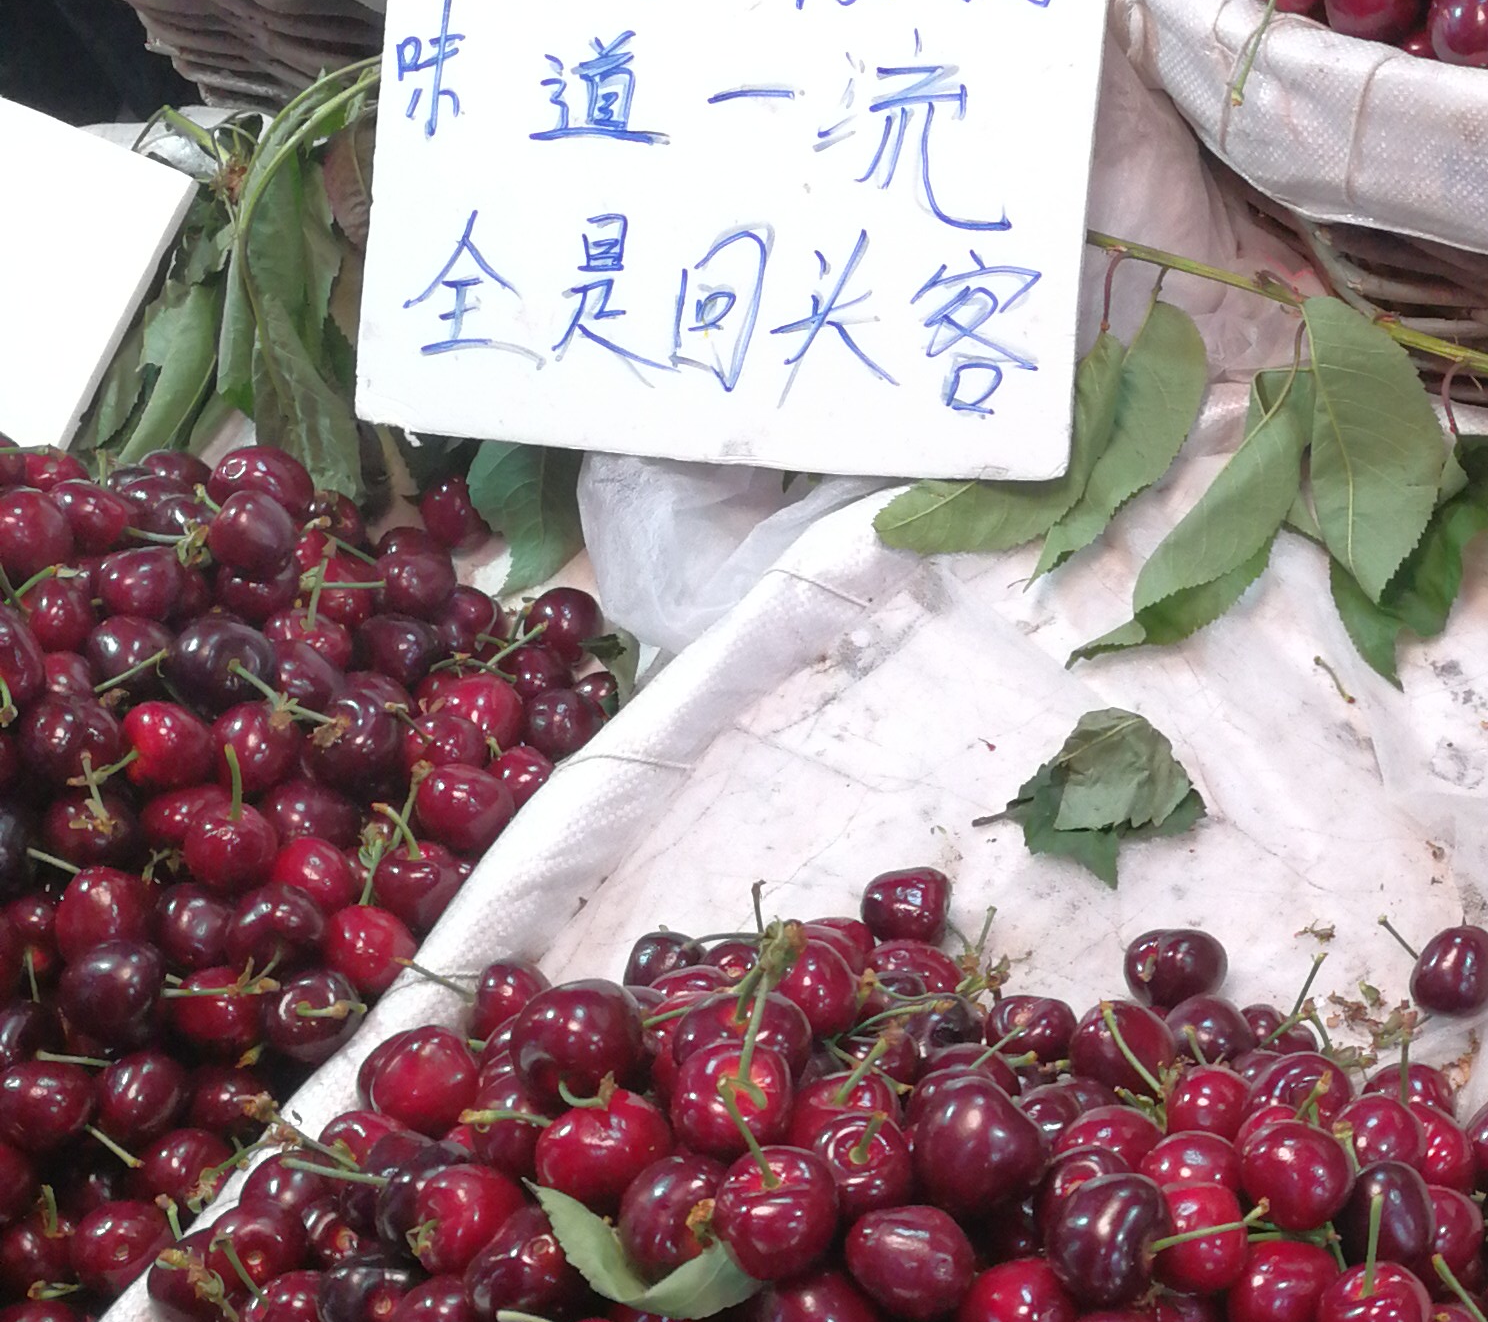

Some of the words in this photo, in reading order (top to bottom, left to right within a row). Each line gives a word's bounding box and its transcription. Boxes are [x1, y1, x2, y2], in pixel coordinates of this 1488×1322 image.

[402, 209, 1044, 415] 全是回头客
